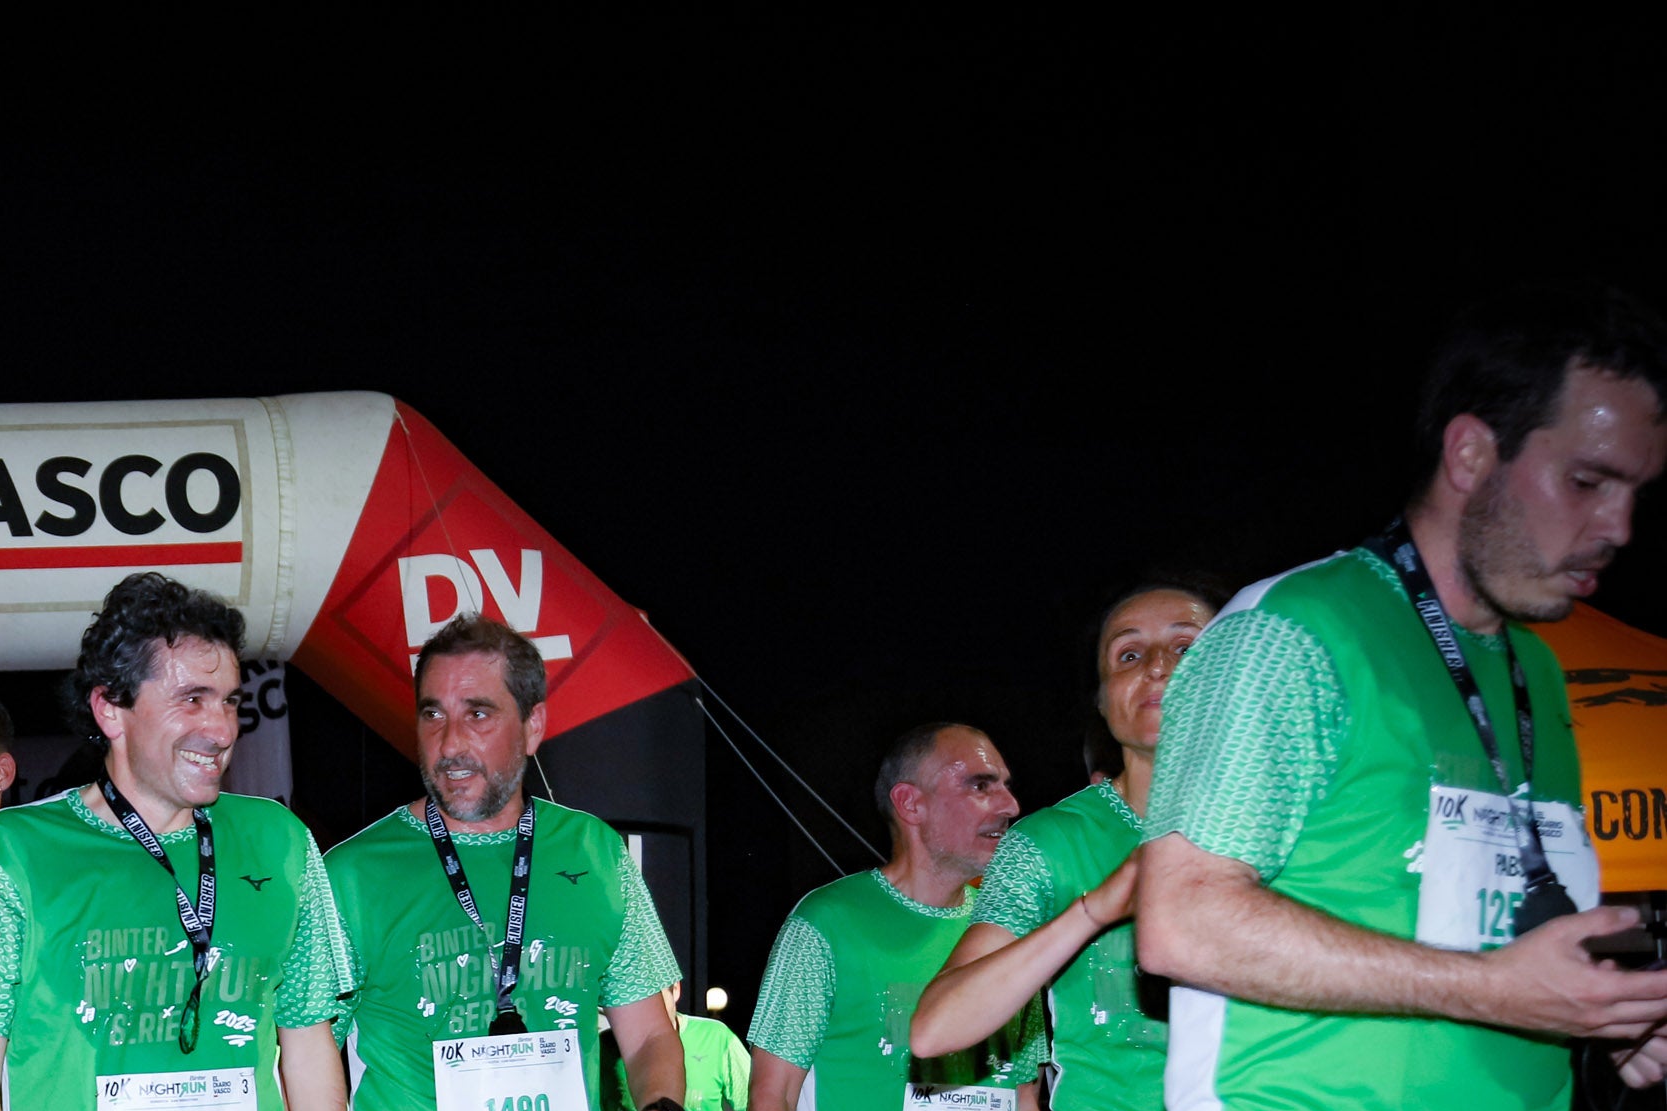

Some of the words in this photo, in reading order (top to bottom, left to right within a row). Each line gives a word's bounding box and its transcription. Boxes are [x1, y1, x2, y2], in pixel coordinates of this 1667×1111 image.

[397, 548, 543, 648] DV
[1435, 794, 1469, 823] 10K
[122, 811, 164, 858] FINISHER
[198, 872, 216, 927] FINISHER
[506, 893, 526, 945] FINISHER
[86, 926, 170, 961] BINTER
[419, 921, 497, 963] BINTER
[213, 1009, 257, 1032] 2025
[440, 1041, 466, 1061] 10K
[564, 1038, 571, 1053] 3
[103, 1078, 132, 1101] 10K
[242, 1079, 249, 1095] 3
[910, 1085, 934, 1104] 10K
